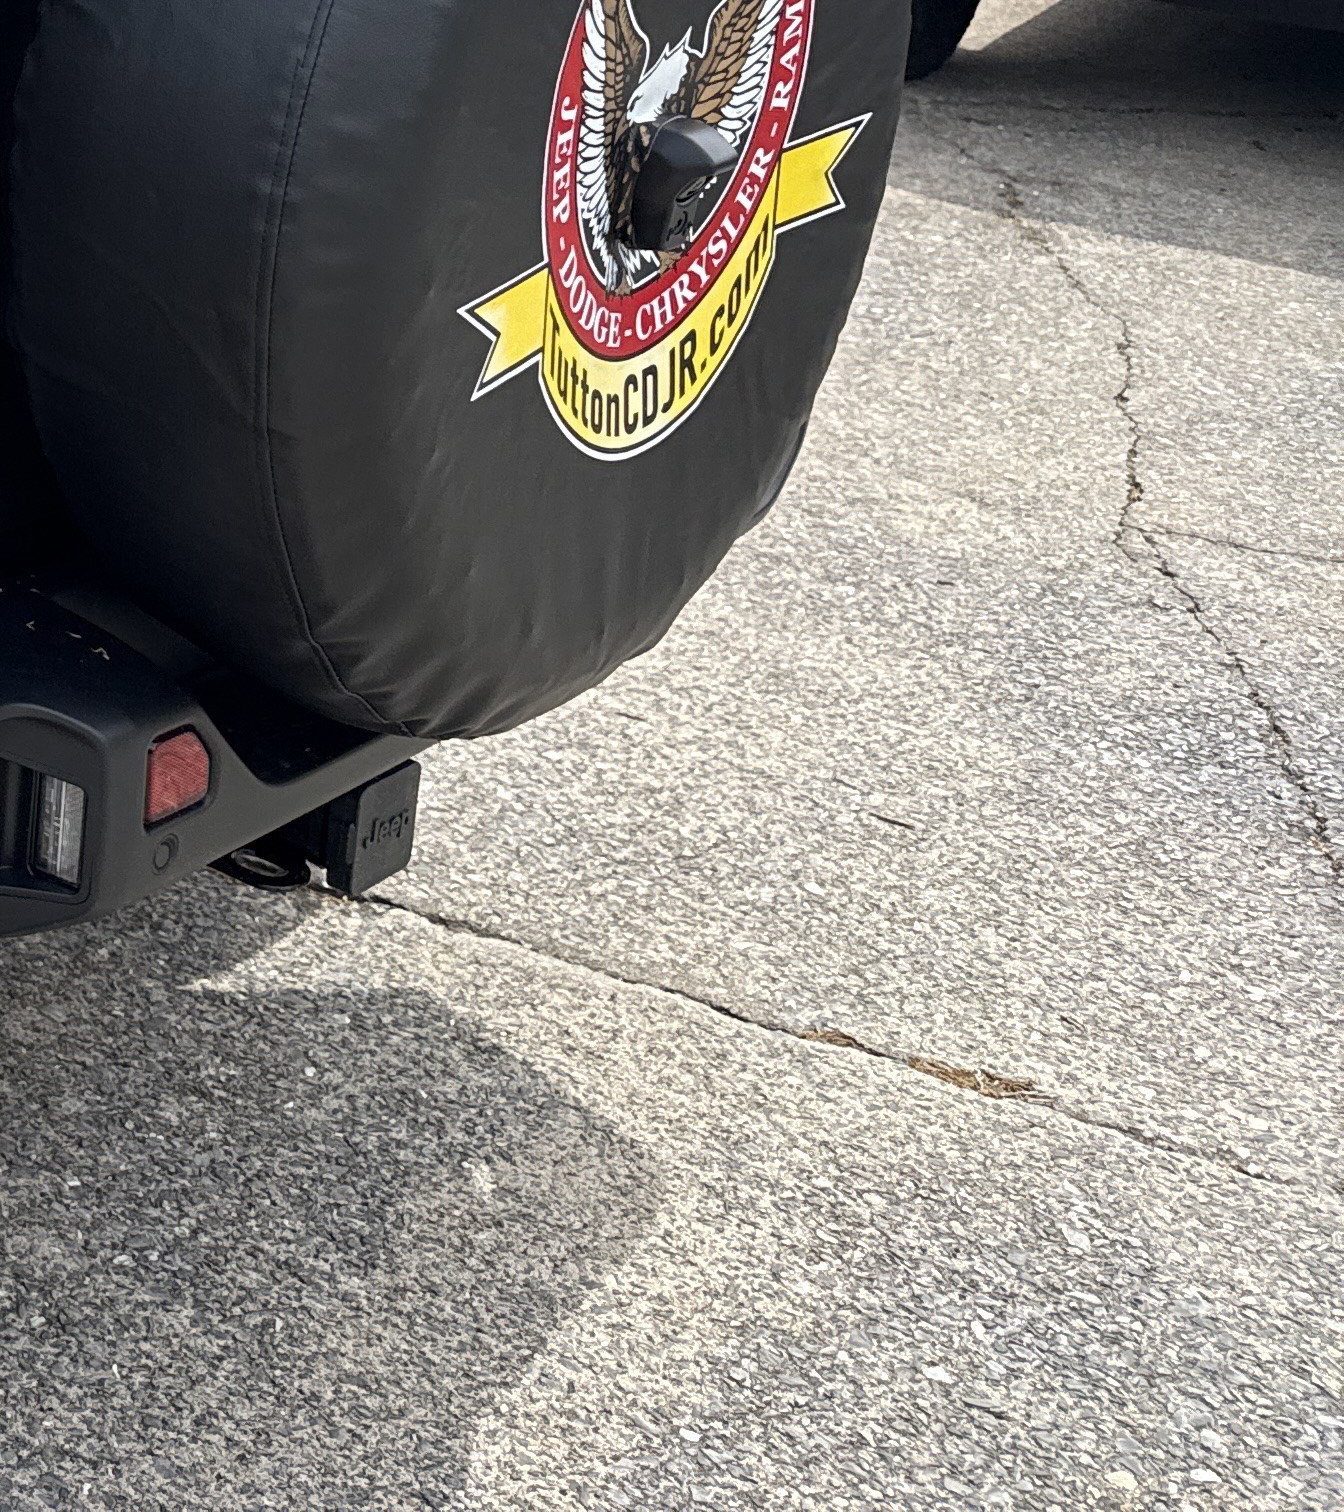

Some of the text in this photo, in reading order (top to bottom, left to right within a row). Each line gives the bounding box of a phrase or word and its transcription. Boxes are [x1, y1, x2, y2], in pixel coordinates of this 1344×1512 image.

[551, 94, 579, 226] JEEP
[558, 248, 623, 349] DODGE
[634, 146, 778, 343] CHRYSLER
[546, 213, 771, 438] TuttonCDJR.com
[361, 808, 410, 849] Jeep
